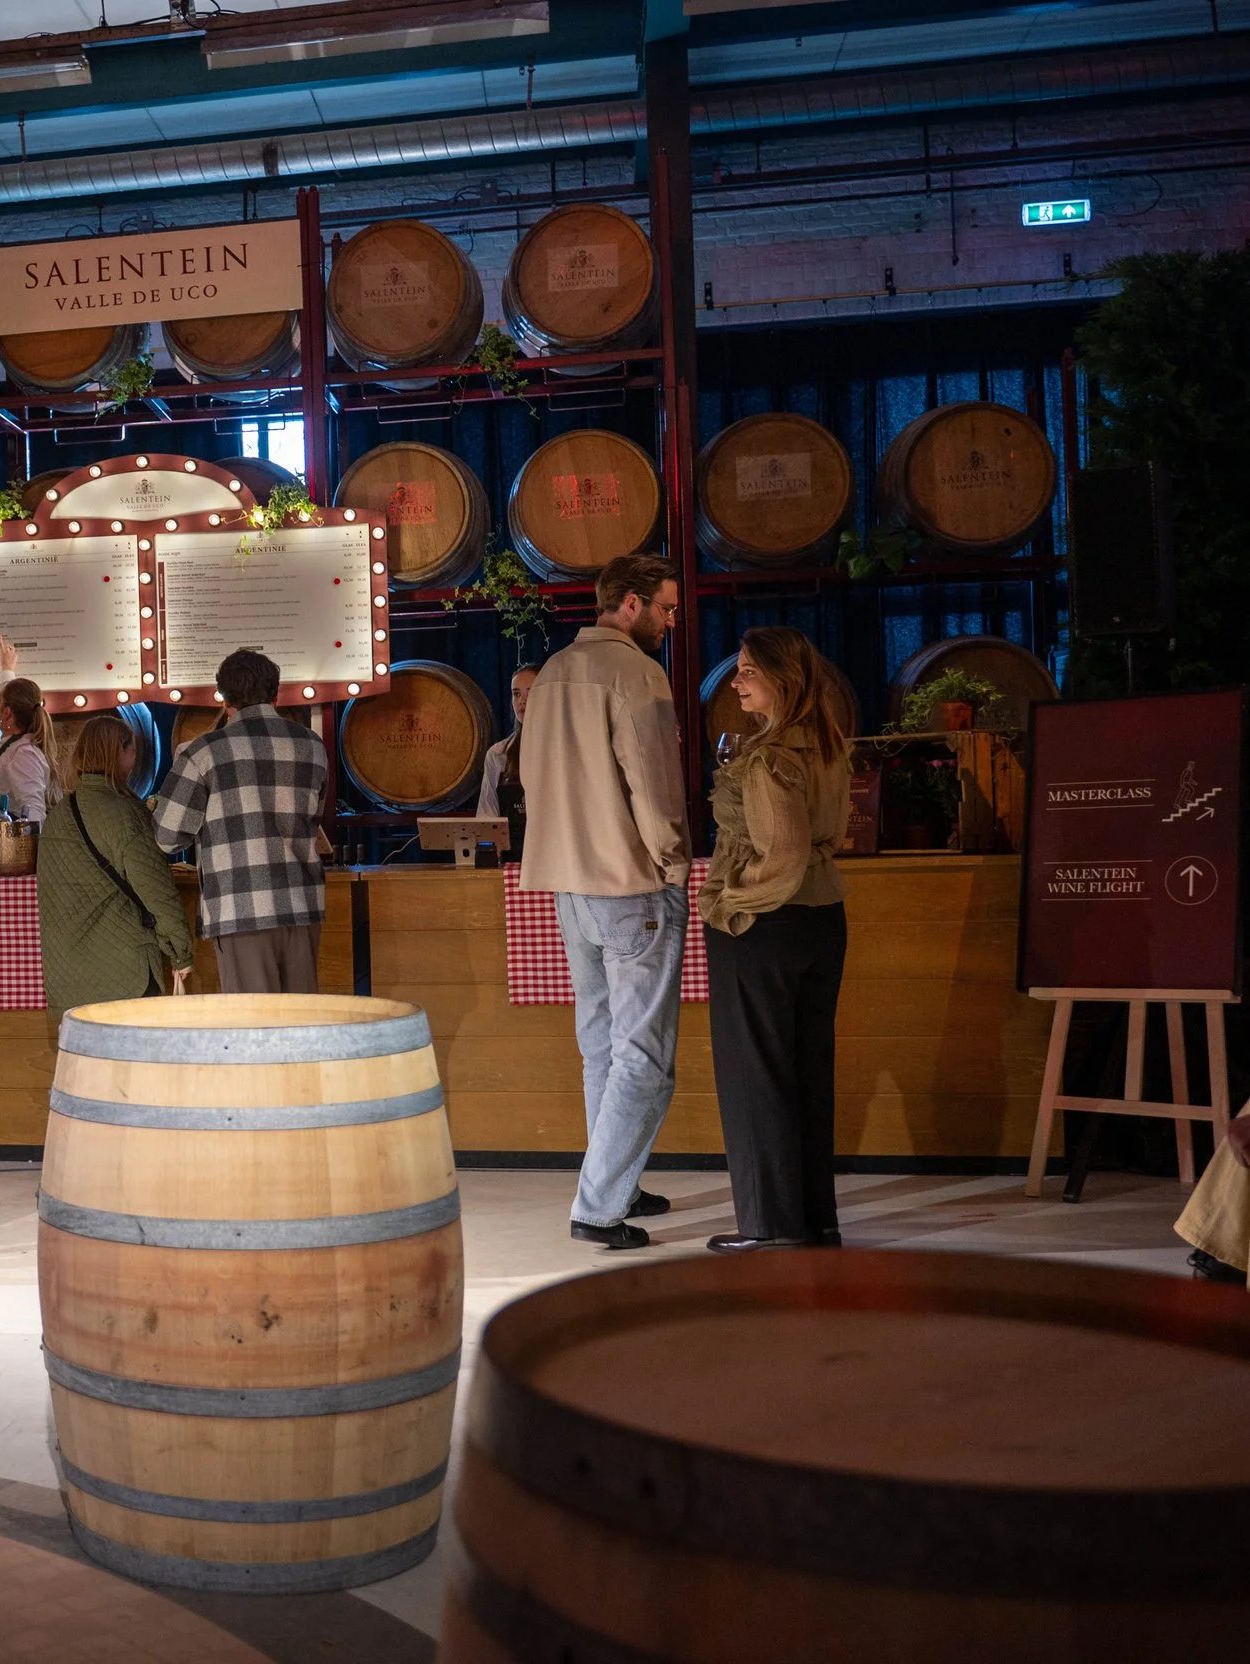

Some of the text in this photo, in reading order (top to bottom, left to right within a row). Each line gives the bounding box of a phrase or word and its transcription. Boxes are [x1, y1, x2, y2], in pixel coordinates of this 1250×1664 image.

[25, 243, 249, 289] SALENTEIN
[551, 269, 616, 281] SALENTEIN
[55, 284, 219, 311] VALLE DE UCO
[364, 286, 427, 298] SALENTEIN
[941, 470, 1012, 484] SALENTEIN
[740, 478, 809, 490] SALENTEIN
[119, 495, 171, 504] SALENTEIN
[556, 498, 620, 510] SALENTEIN
[379, 732, 442, 743] SALENTEIN
[1048, 787, 1151, 802] MASTERCLASS
[1055, 867, 1137, 879] SALENTEIN
[1048, 881, 1145, 893] WINE FLIGHT
